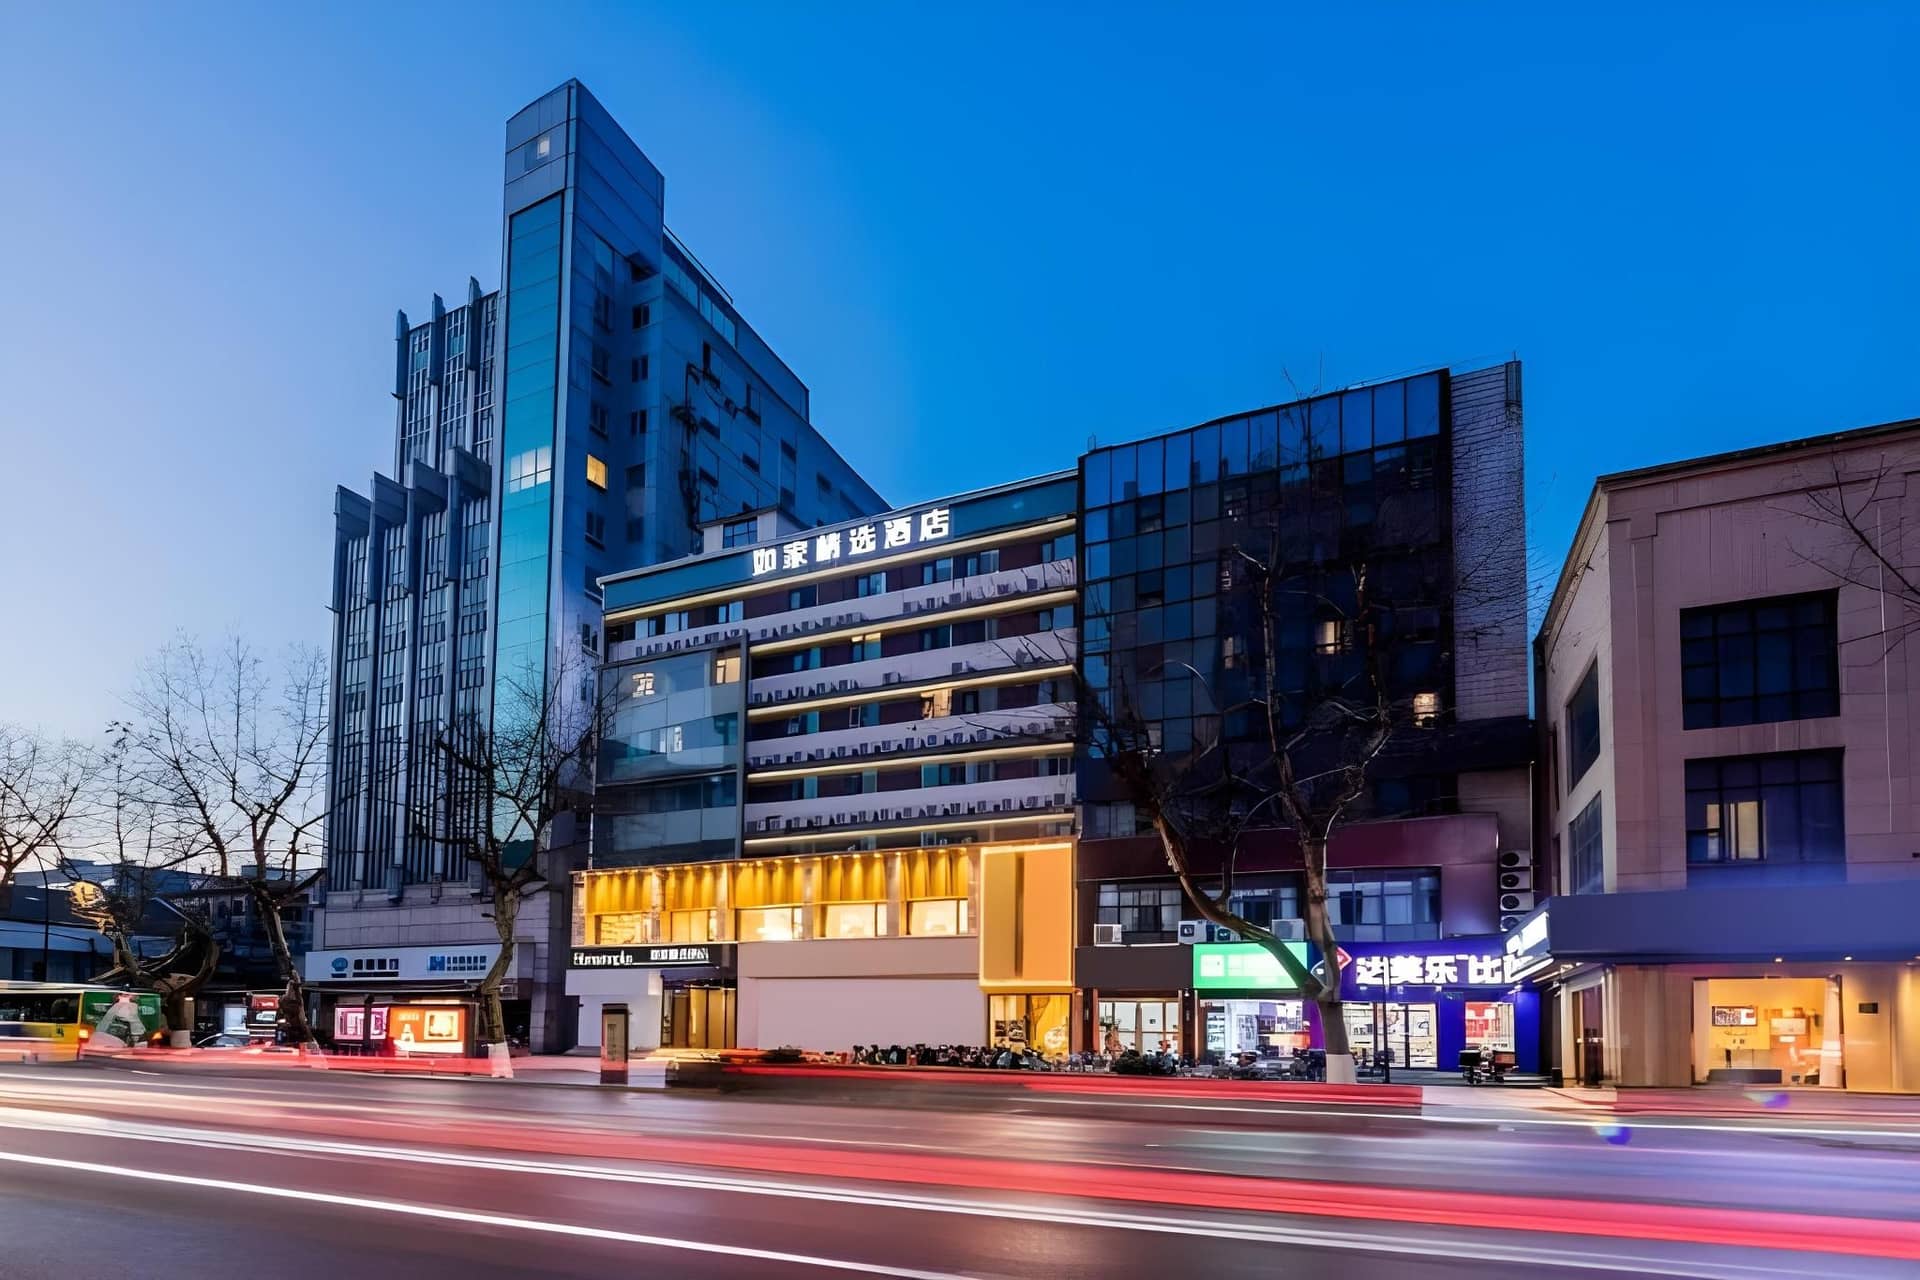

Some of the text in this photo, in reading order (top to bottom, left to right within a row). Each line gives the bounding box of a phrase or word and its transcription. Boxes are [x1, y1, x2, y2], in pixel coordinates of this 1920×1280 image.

[752, 508, 949, 576] 如家精选酒店
